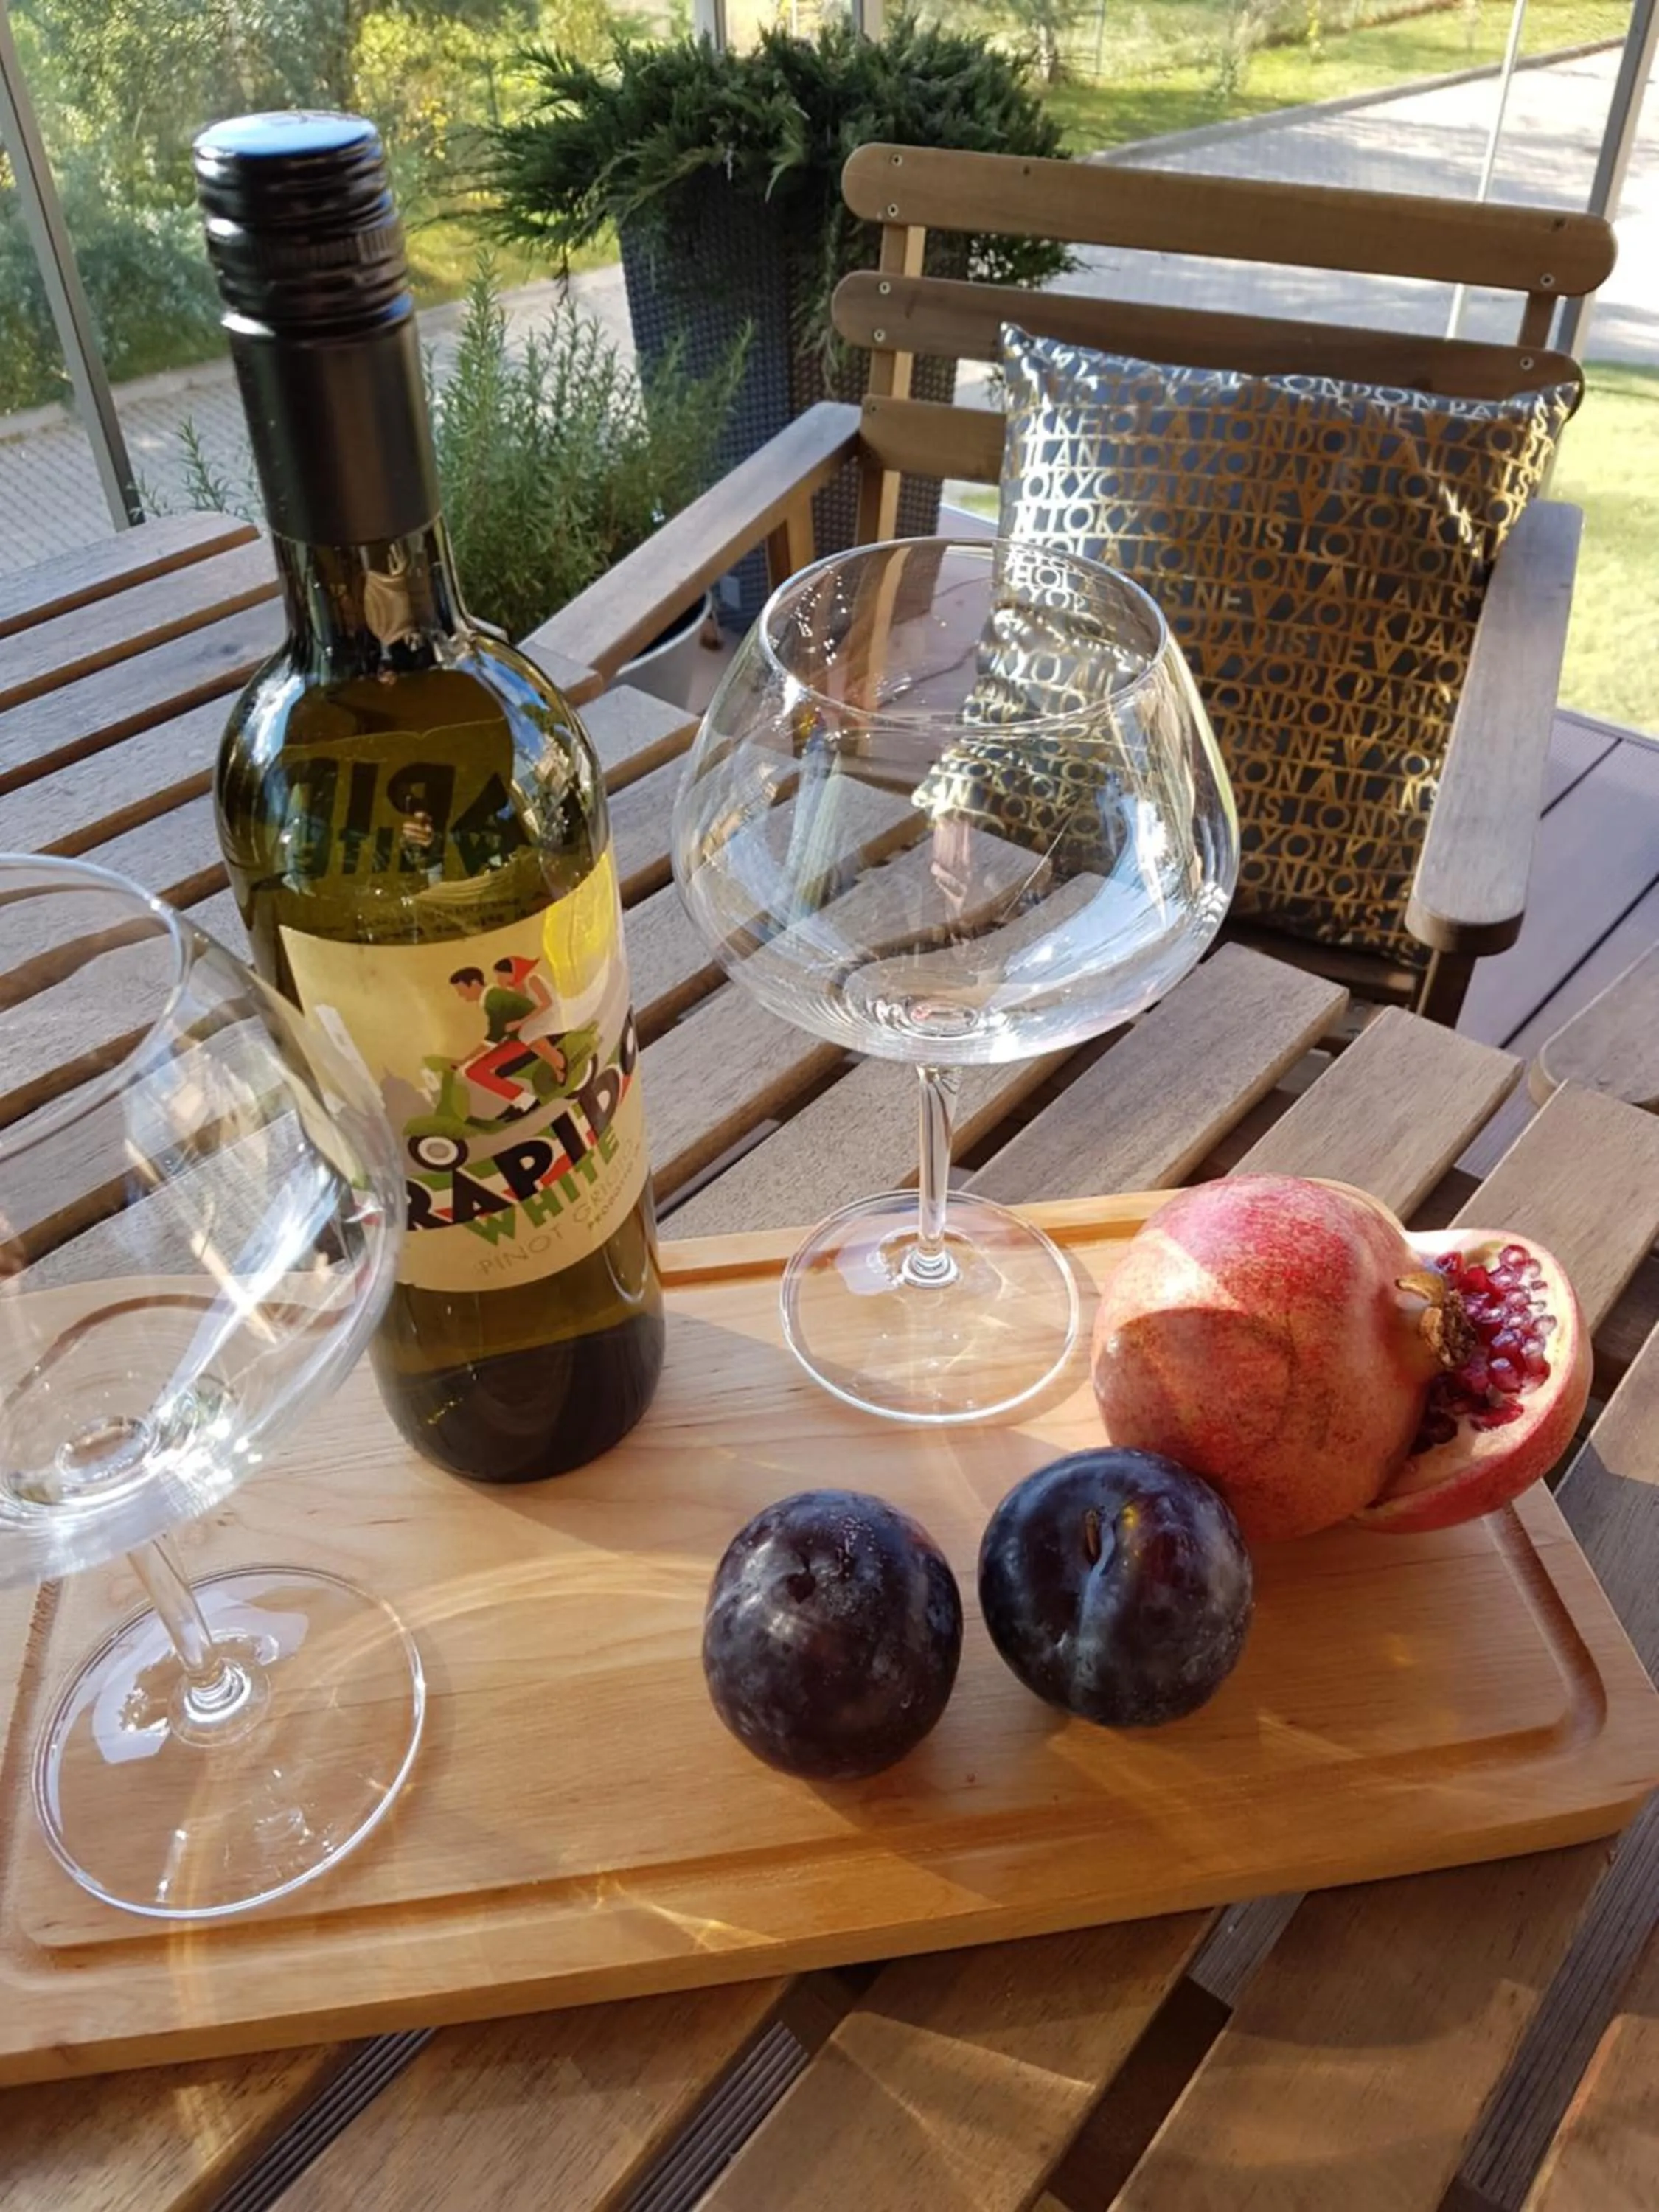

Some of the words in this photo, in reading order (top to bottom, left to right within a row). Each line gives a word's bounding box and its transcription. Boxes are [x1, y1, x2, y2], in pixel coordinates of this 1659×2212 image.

[1262, 375, 1439, 411] LONDON
[1203, 413, 1385, 462] LONDON
[1256, 450, 1364, 493] PARIS
[1020, 470, 1124, 504] OKYO
[1131, 472, 1233, 515] PARIS
[1333, 491, 1445, 546] YORK
[1040, 501, 1175, 543] TOKYO
[1178, 509, 1287, 554] PARIS
[1296, 524, 1476, 588] LONDON
[1134, 540, 1311, 593] LONDON
[1205, 618, 1308, 659] PARIS
[1286, 590, 1397, 644] YORK
[1402, 611, 1473, 658] PAR
[1234, 653, 1352, 706] YORK
[1352, 669, 1453, 721] PARIS
[1370, 706, 1447, 755] PARI
[1295, 795, 1430, 841] LONDO
[1252, 821, 1367, 872] YORK
[1239, 854, 1386, 902] ONDON
[462, 1124, 620, 1248] WHITE
[475, 1222, 565, 1277] PINOT
